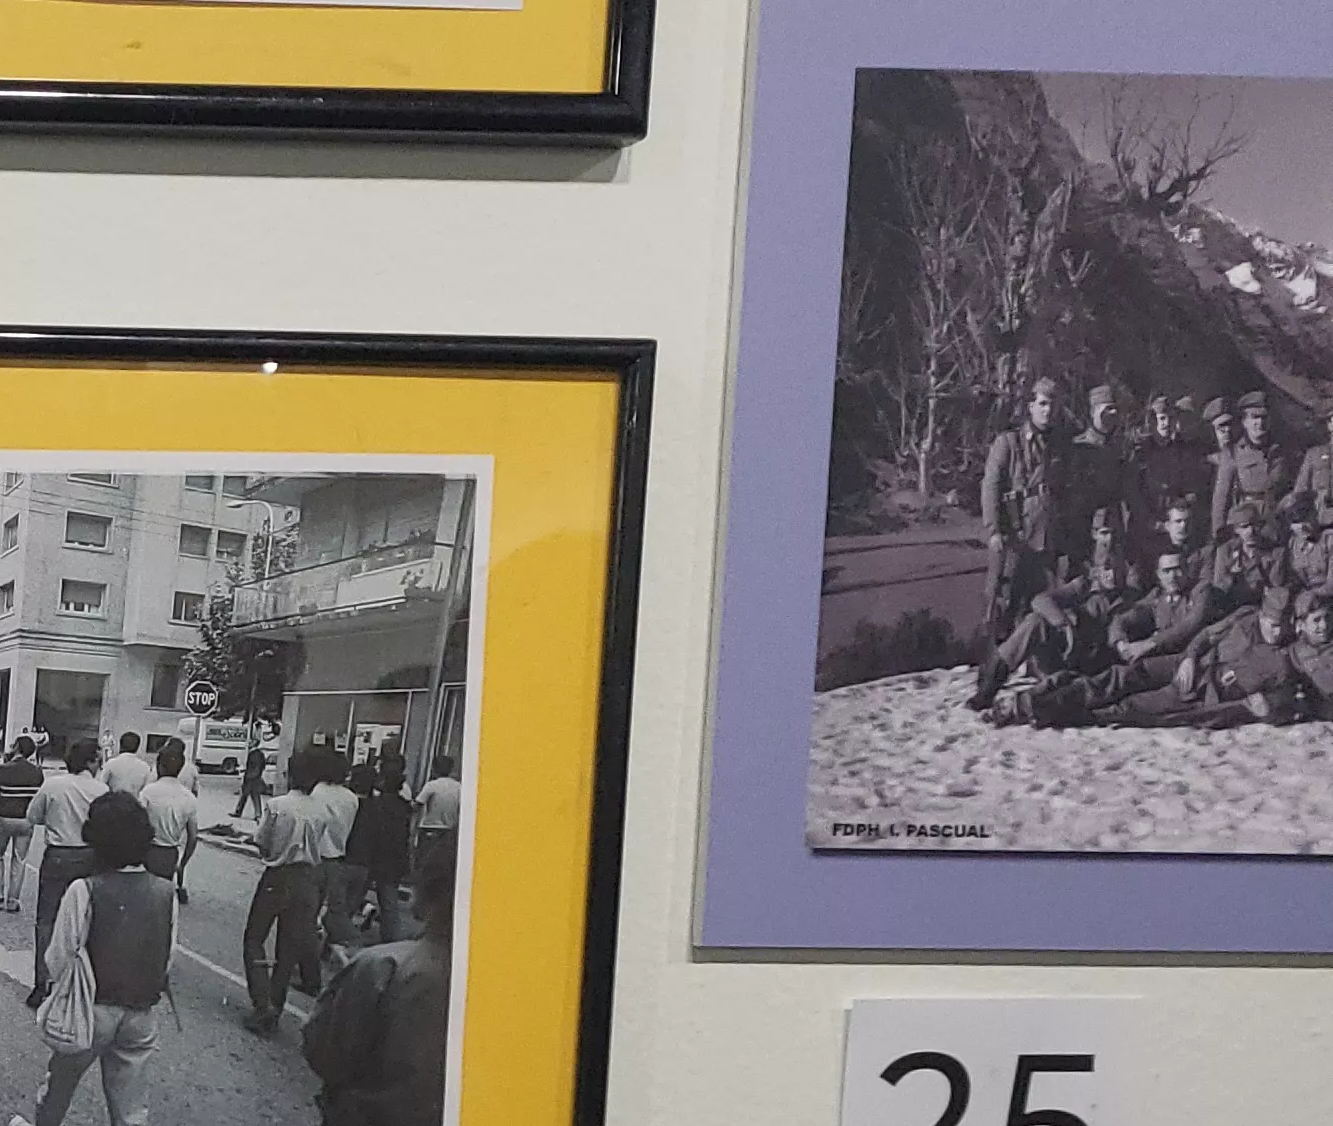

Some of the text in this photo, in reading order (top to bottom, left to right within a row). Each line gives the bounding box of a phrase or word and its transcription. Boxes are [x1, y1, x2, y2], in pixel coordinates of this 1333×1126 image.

[187, 692, 215, 705] STOP
[833, 823, 880, 836] FDPH
[907, 824, 991, 838] PASCUAL
